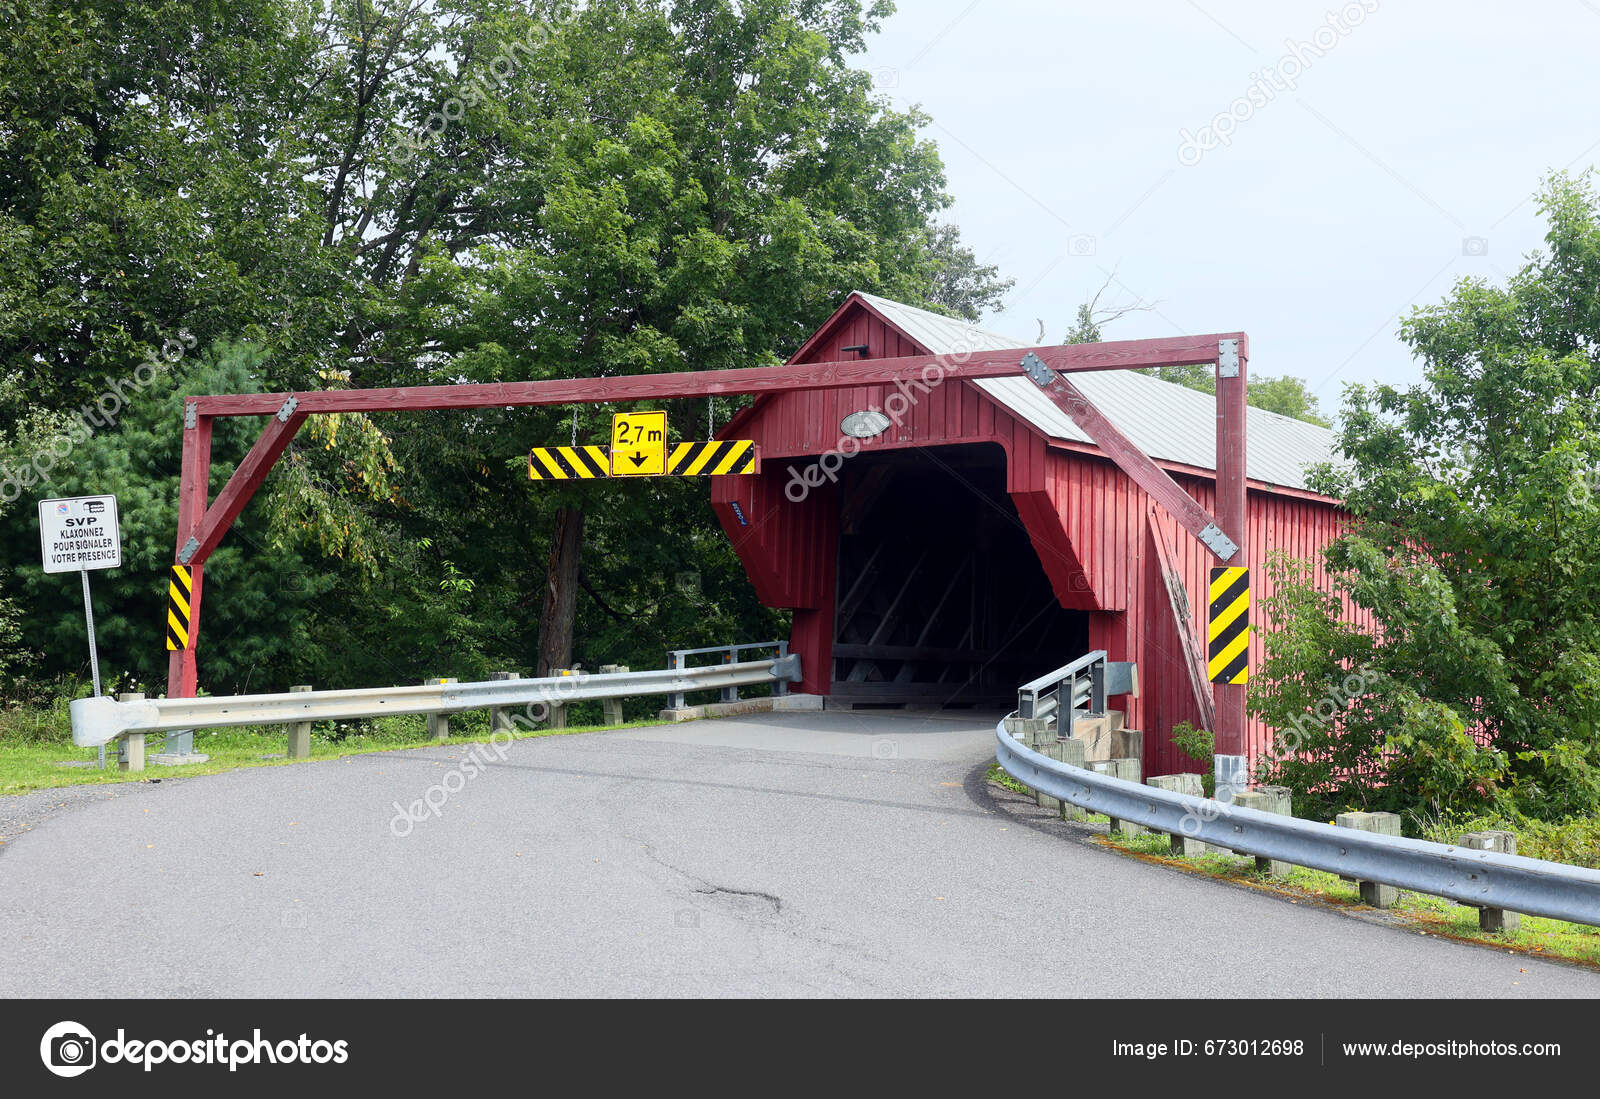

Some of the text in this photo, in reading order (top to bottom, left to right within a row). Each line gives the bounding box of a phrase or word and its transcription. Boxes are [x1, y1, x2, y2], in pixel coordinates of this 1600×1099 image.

[648, 430, 662, 442] m
[65, 516, 97, 527] SVP
[60, 527, 104, 539] KLAXONNEZ
[54, 538, 113, 552] POUR SIGNALER
[52, 549, 116, 564] VOTRE PRESENCE
